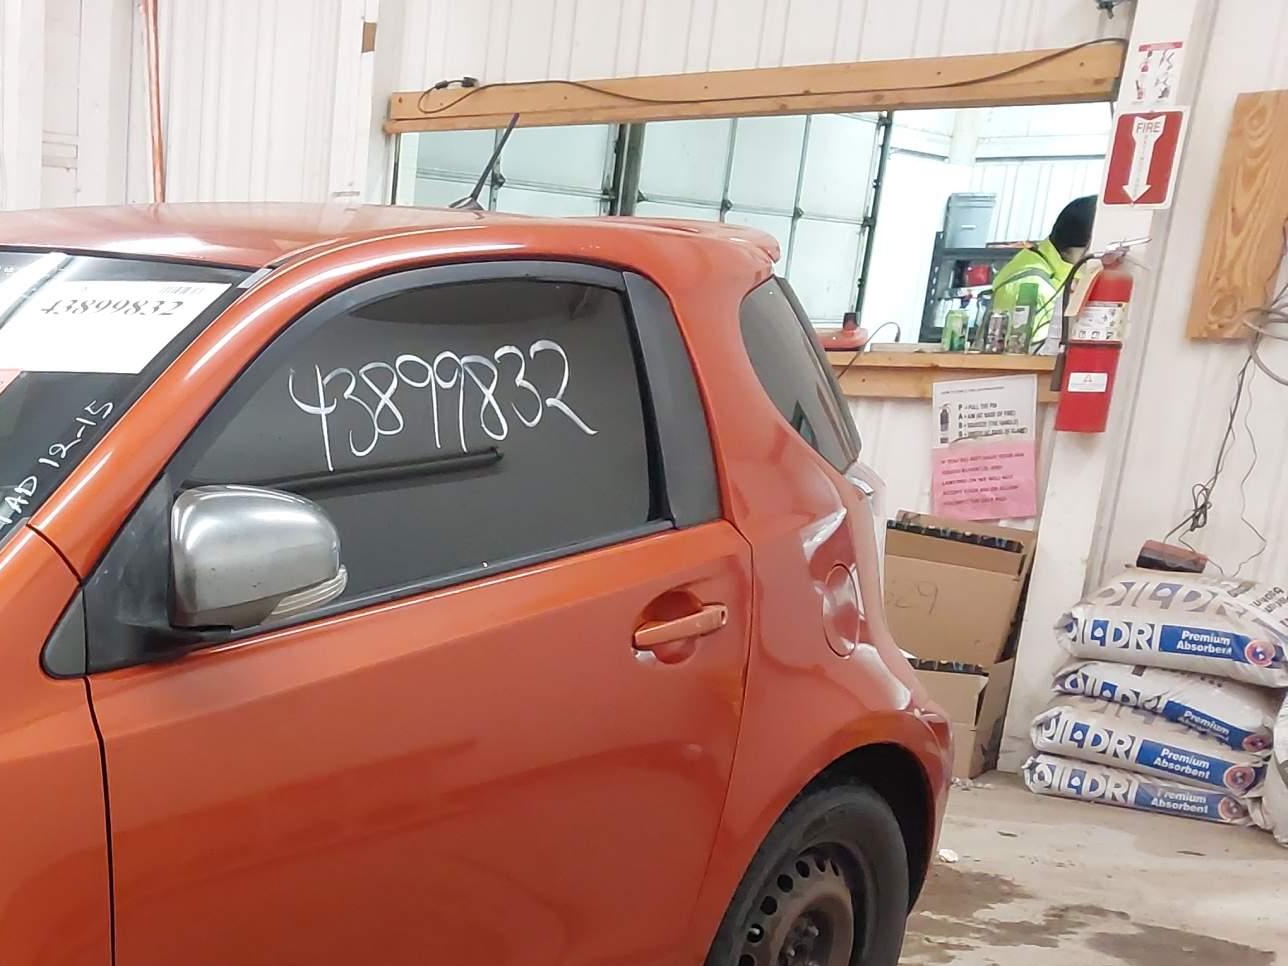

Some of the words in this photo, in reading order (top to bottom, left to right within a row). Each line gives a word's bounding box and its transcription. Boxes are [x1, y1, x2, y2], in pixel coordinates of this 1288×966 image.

[1136, 121, 1161, 134] FIRE
[39, 299, 185, 317] 43899832
[288, 339, 599, 473] 43899832
[38, 400, 114, 468] 12-15
[1176, 640, 1233, 655] Absorbent
[1181, 630, 1232, 646] Premium
[1183, 710, 1230, 735] Premium
[1160, 747, 1210, 769] Premium
[1153, 757, 1211, 780] Absorbent
[1150, 797, 1209, 815] Absorbent
